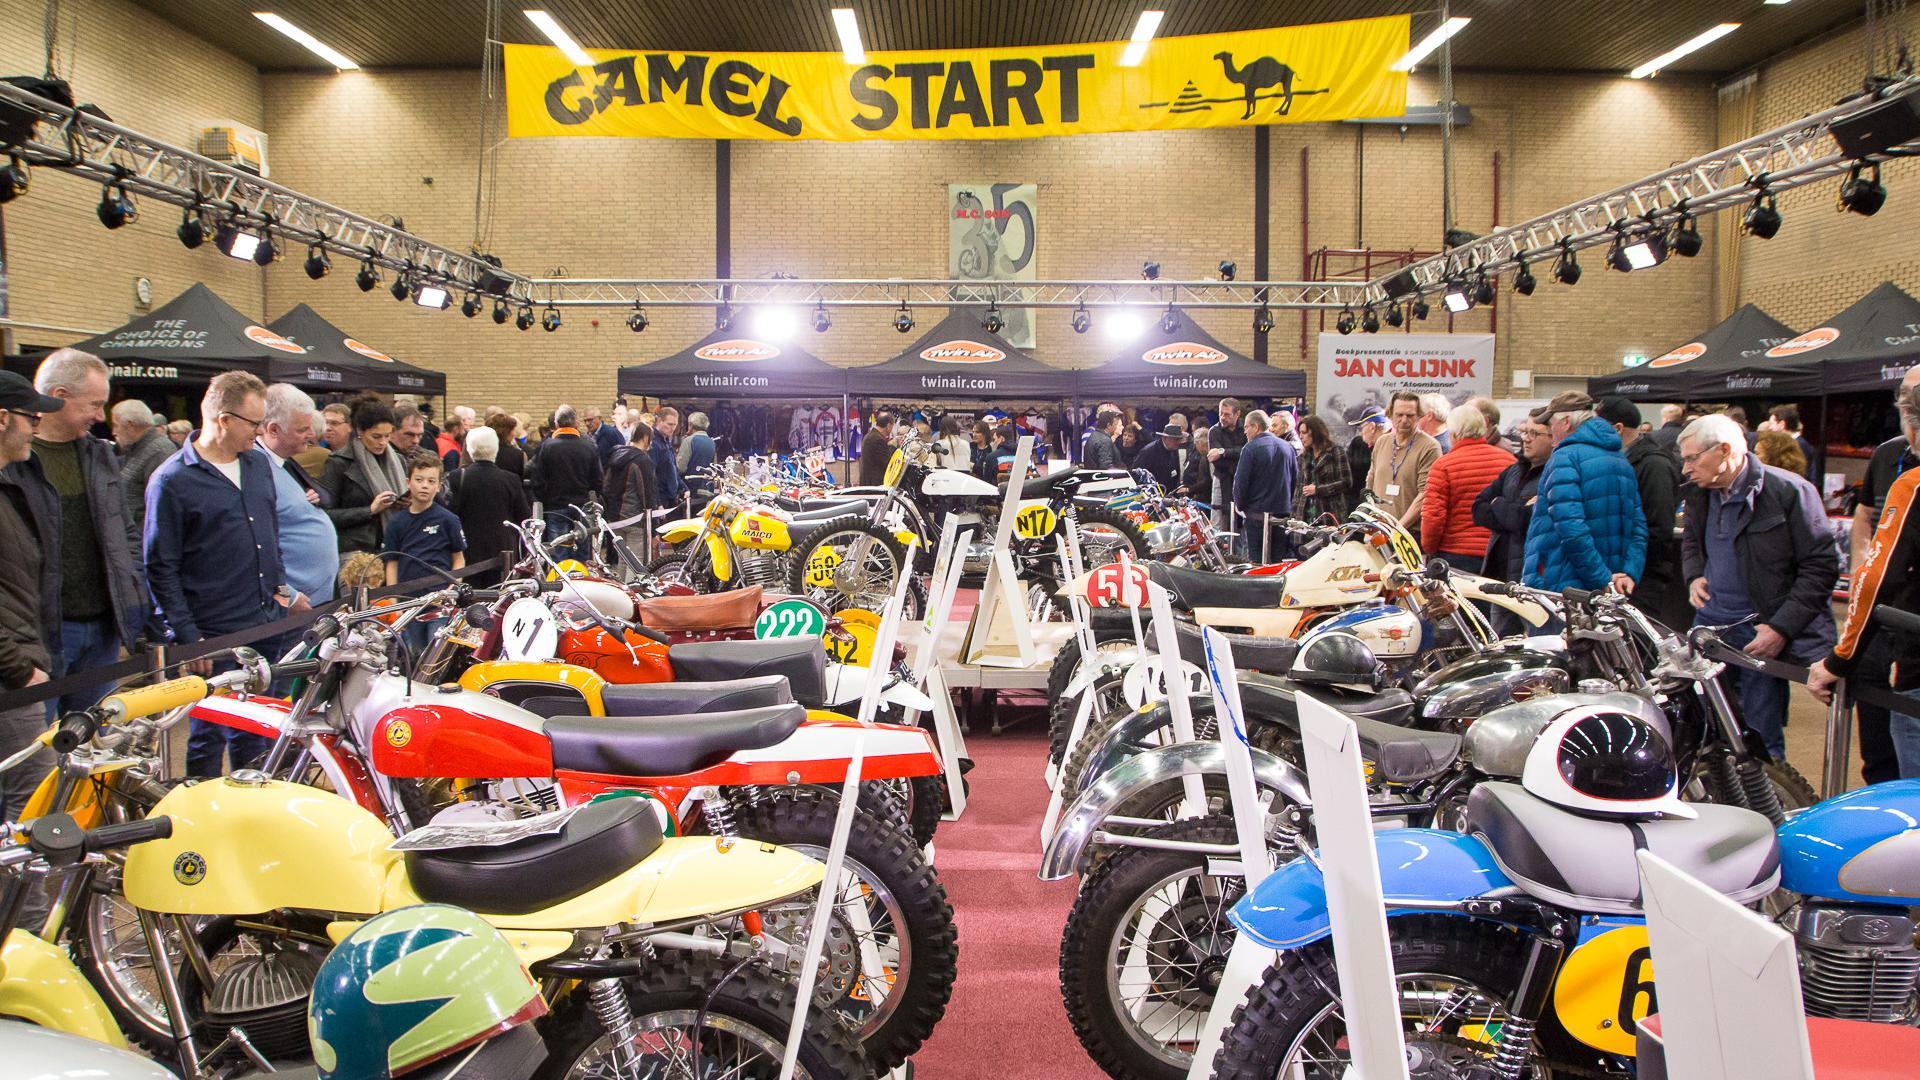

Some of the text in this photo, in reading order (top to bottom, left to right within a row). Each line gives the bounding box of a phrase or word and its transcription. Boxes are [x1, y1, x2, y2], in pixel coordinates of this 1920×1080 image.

[543, 54, 1096, 136] CAMEL START
[153, 319, 188, 328] THE
[115, 329, 209, 339] CHOICE OF
[99, 340, 206, 348] CHAMPIONS
[1335, 348, 1401, 356] Boekpresentatie
[1334, 358, 1476, 378] JAN CLIJNK
[693, 373, 769, 387] twinair.com
[921, 375, 996, 390] twinair.com
[1153, 375, 1228, 389] twinair.com
[1017, 508, 1048, 536] N17
[741, 528, 773, 539] MAICO
[1098, 569, 1143, 608] 56
[760, 608, 814, 641] 222
[521, 617, 544, 657] 1
[1617, 946, 1659, 1036] 6
